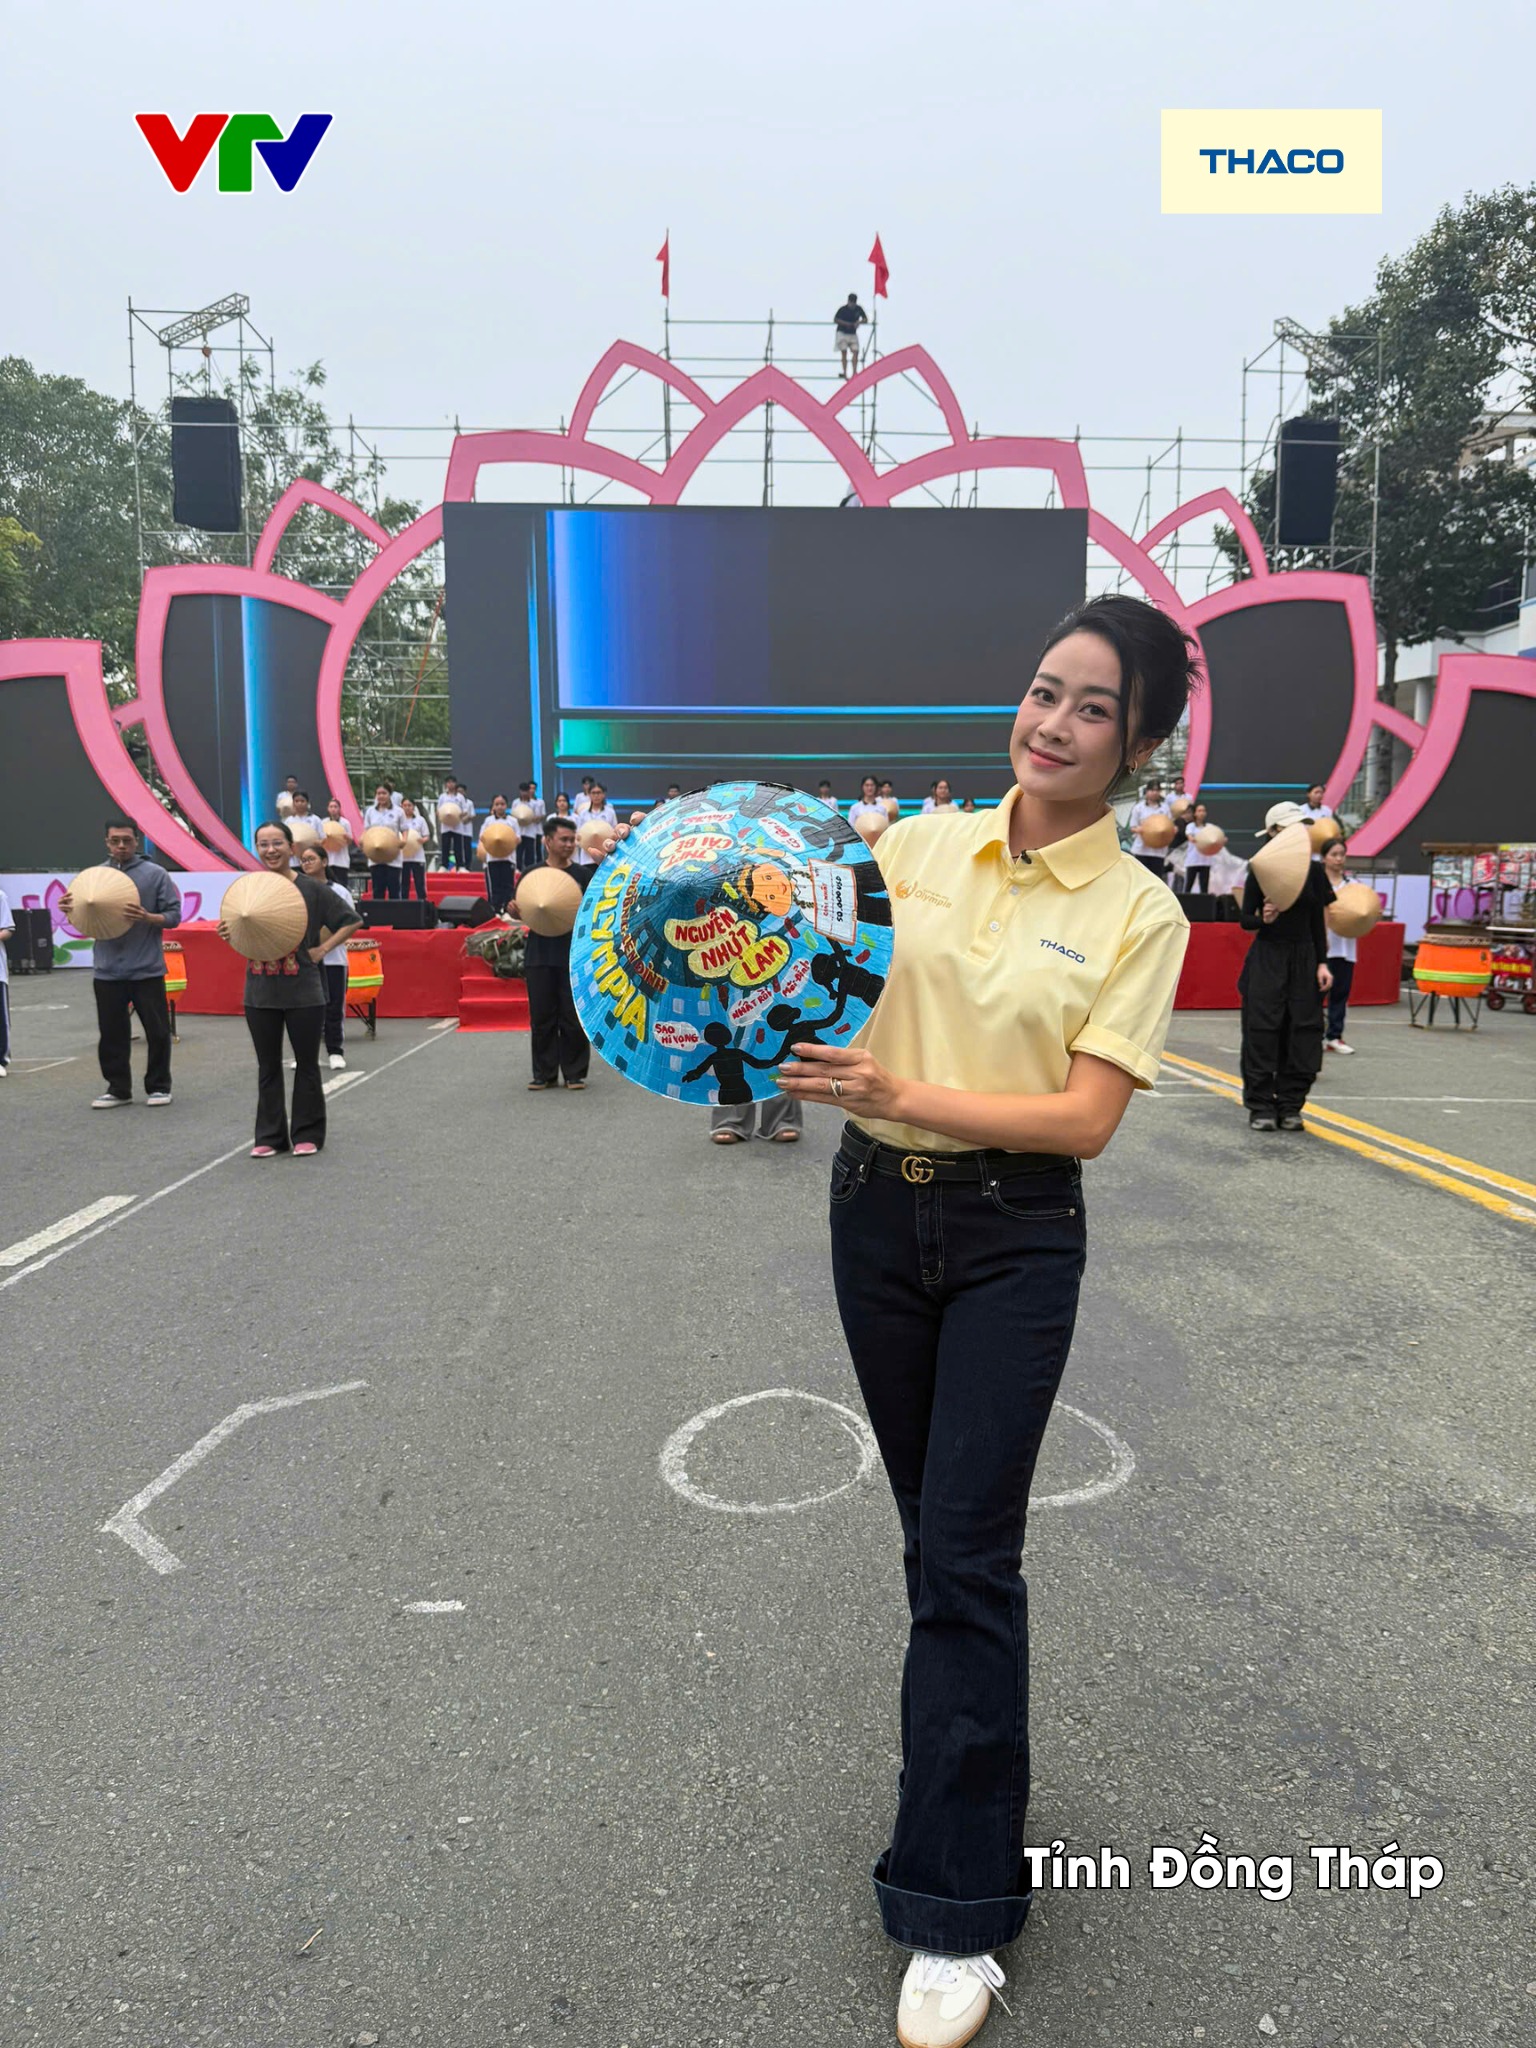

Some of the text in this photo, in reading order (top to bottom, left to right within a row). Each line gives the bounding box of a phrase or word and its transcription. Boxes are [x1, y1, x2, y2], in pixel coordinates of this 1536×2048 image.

[664, 850, 707, 868] THPT
[675, 906, 736, 943] NGUYỄN
[590, 863, 648, 1043] OLYMPIA
[742, 939, 783, 980] LAM
[1040, 939, 1086, 964] THACO
[655, 1023, 675, 1034] SAO
[673, 1033, 699, 1048] VỌNG
